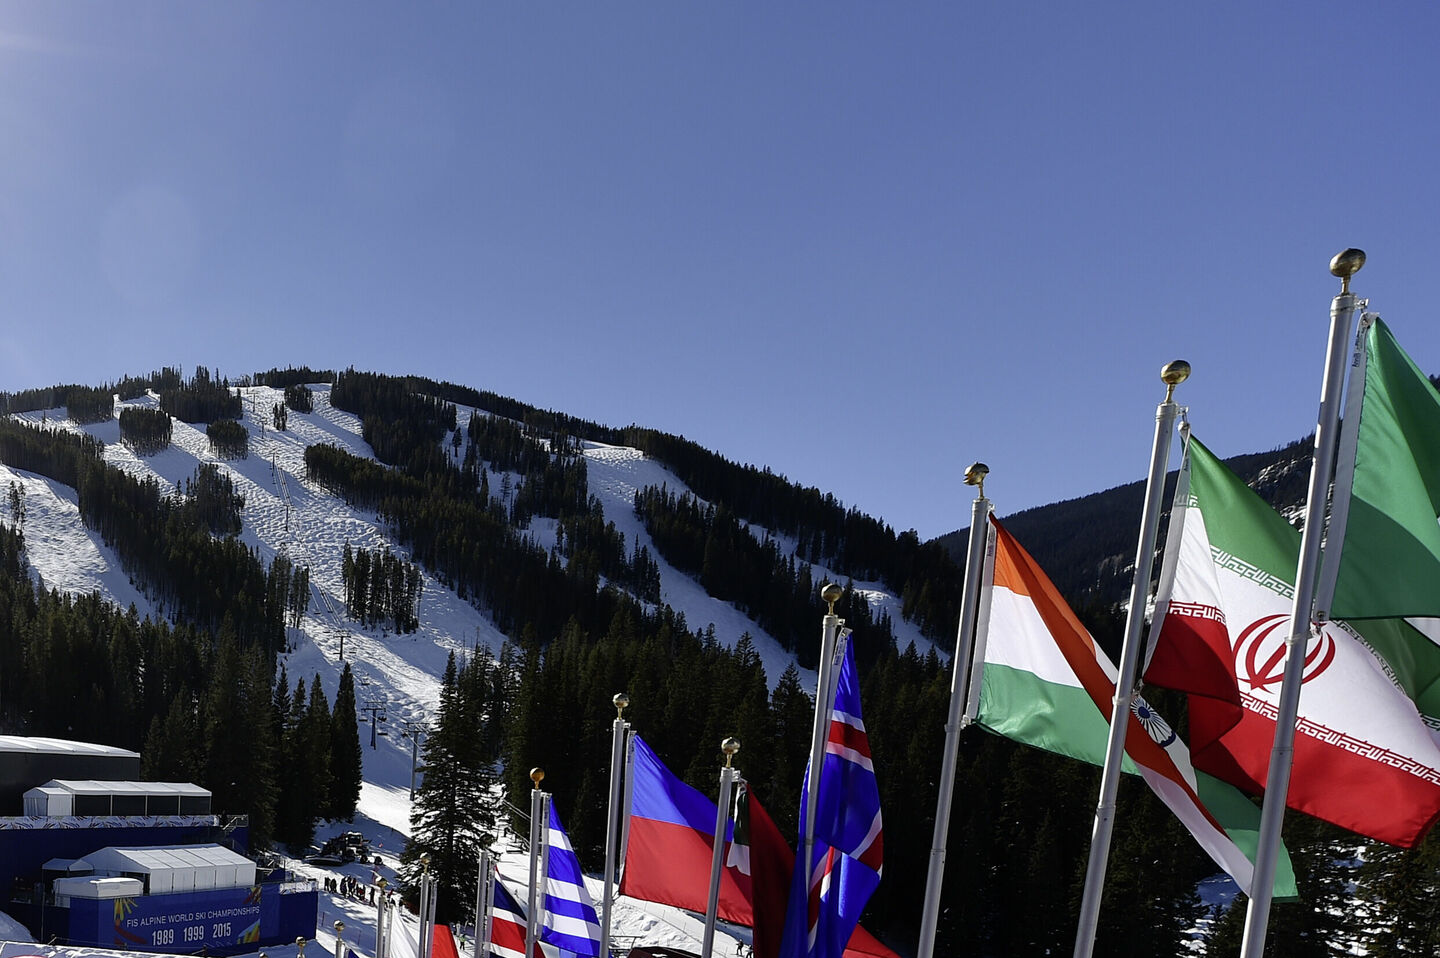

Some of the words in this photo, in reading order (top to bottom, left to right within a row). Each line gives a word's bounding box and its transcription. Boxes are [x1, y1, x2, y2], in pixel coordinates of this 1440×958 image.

[126, 919, 139, 928] FIS
[140, 916, 167, 926] ALPINE
[168, 913, 194, 923] WORLD
[195, 912, 207, 921] SKI
[208, 905, 260, 919] CHAMPIONSHIPS
[151, 929, 174, 946] 1989
[183, 925, 205, 942] 1999
[212, 922, 232, 939] 2015
